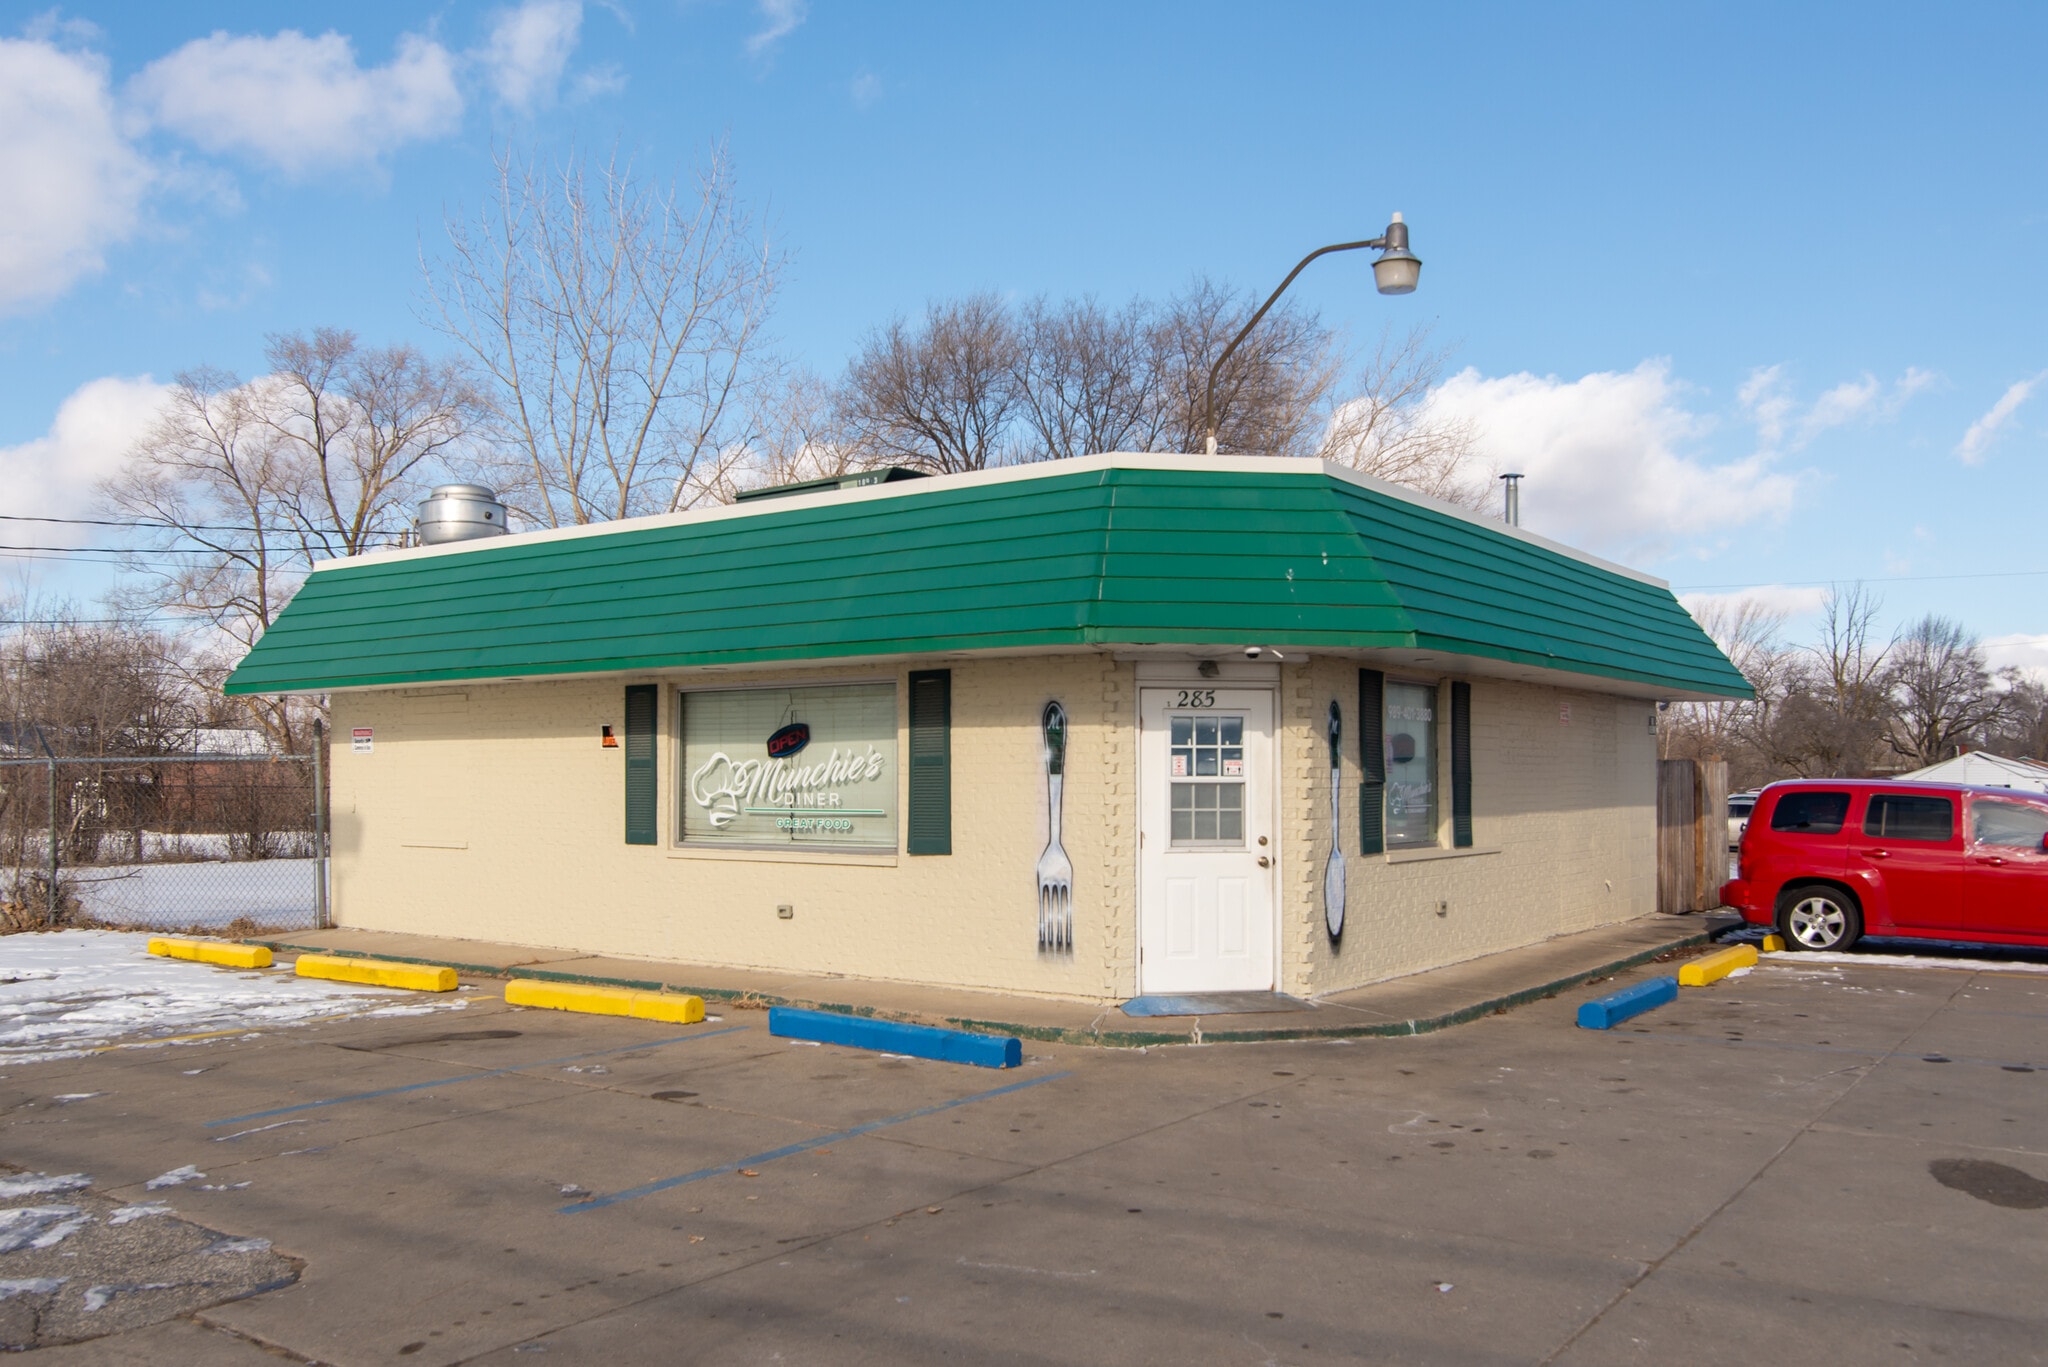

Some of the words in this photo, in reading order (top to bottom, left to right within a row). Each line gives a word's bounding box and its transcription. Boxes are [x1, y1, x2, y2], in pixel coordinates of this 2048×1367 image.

[1177, 689, 1216, 708] 285
[768, 729, 807, 753] OPEN
[734, 744, 885, 804] Munchie's
[784, 792, 840, 806] DINER
[776, 818, 815, 829] GREAT
[817, 819, 851, 830] FOOD
